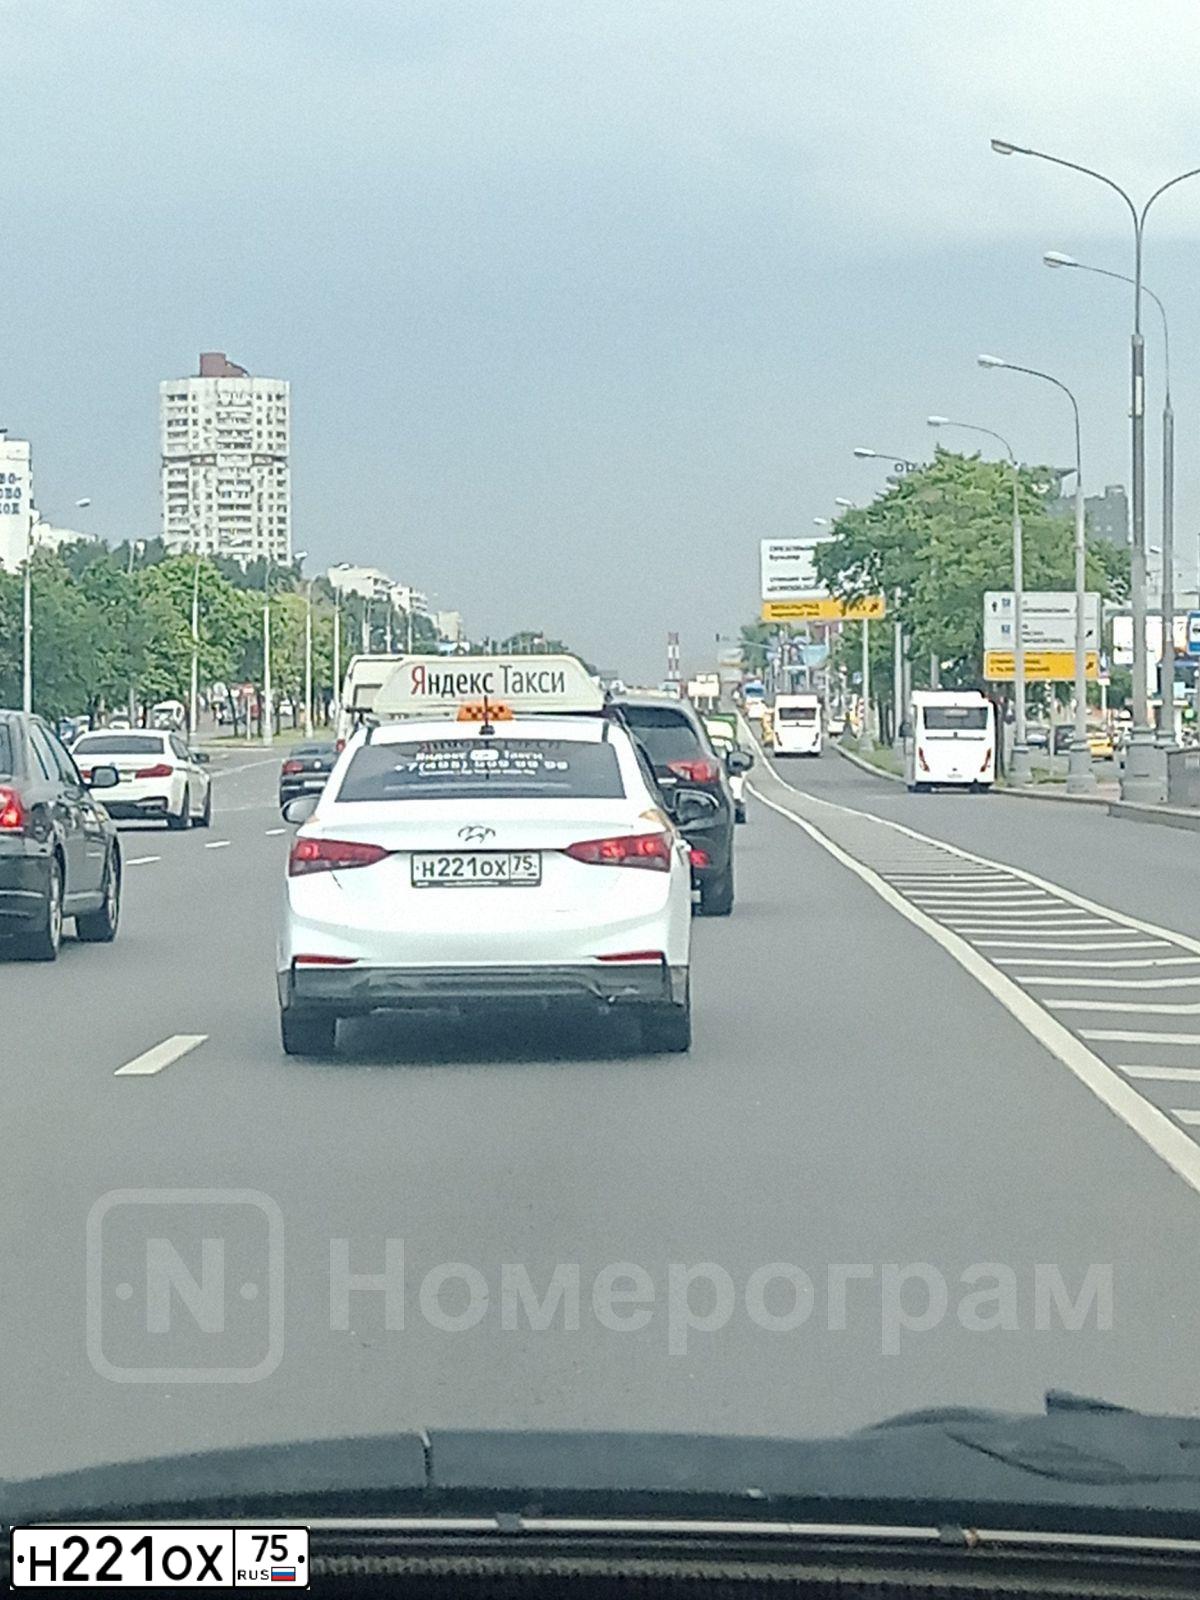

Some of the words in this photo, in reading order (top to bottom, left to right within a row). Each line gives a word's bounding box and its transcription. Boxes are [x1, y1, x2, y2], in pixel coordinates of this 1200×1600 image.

[411, 665, 494, 697] Яндекс
[500, 665, 565, 694] Такси
[422, 857, 506, 877] Н221ОХ
[513, 855, 533, 871] 75
